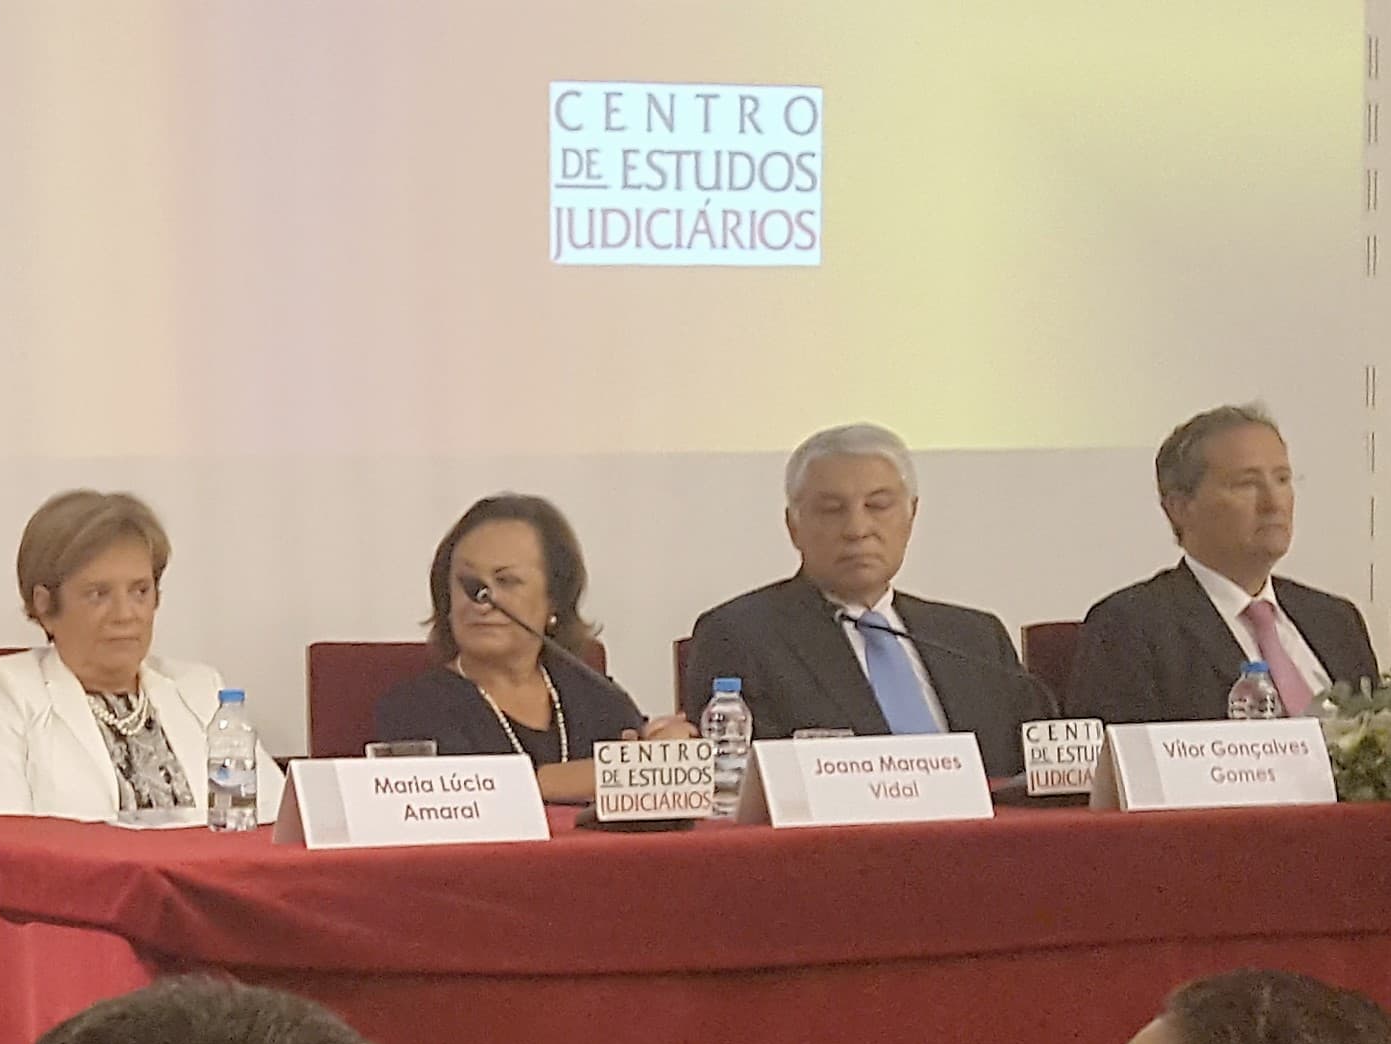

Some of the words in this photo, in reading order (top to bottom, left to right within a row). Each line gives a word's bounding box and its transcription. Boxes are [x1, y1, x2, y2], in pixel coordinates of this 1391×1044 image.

[554, 90, 819, 136] CENTRO
[561, 148, 604, 180] DE
[620, 149, 818, 193] ESTUDOS
[553, 198, 817, 261] JUDICIÁRIOS
[598, 742, 713, 764] CENTRO
[1210, 739, 1309, 760] Gonçalves
[814, 757, 874, 775] Joana
[879, 755, 963, 775] Marques
[1210, 765, 1277, 783] Gomes
[374, 775, 434, 794] Maria
[439, 771, 497, 793] Lúcia
[602, 768, 621, 784] DE
[628, 766, 713, 788] ESTUDOS
[869, 779, 920, 799] Vidal
[404, 800, 480, 821] Amaral
